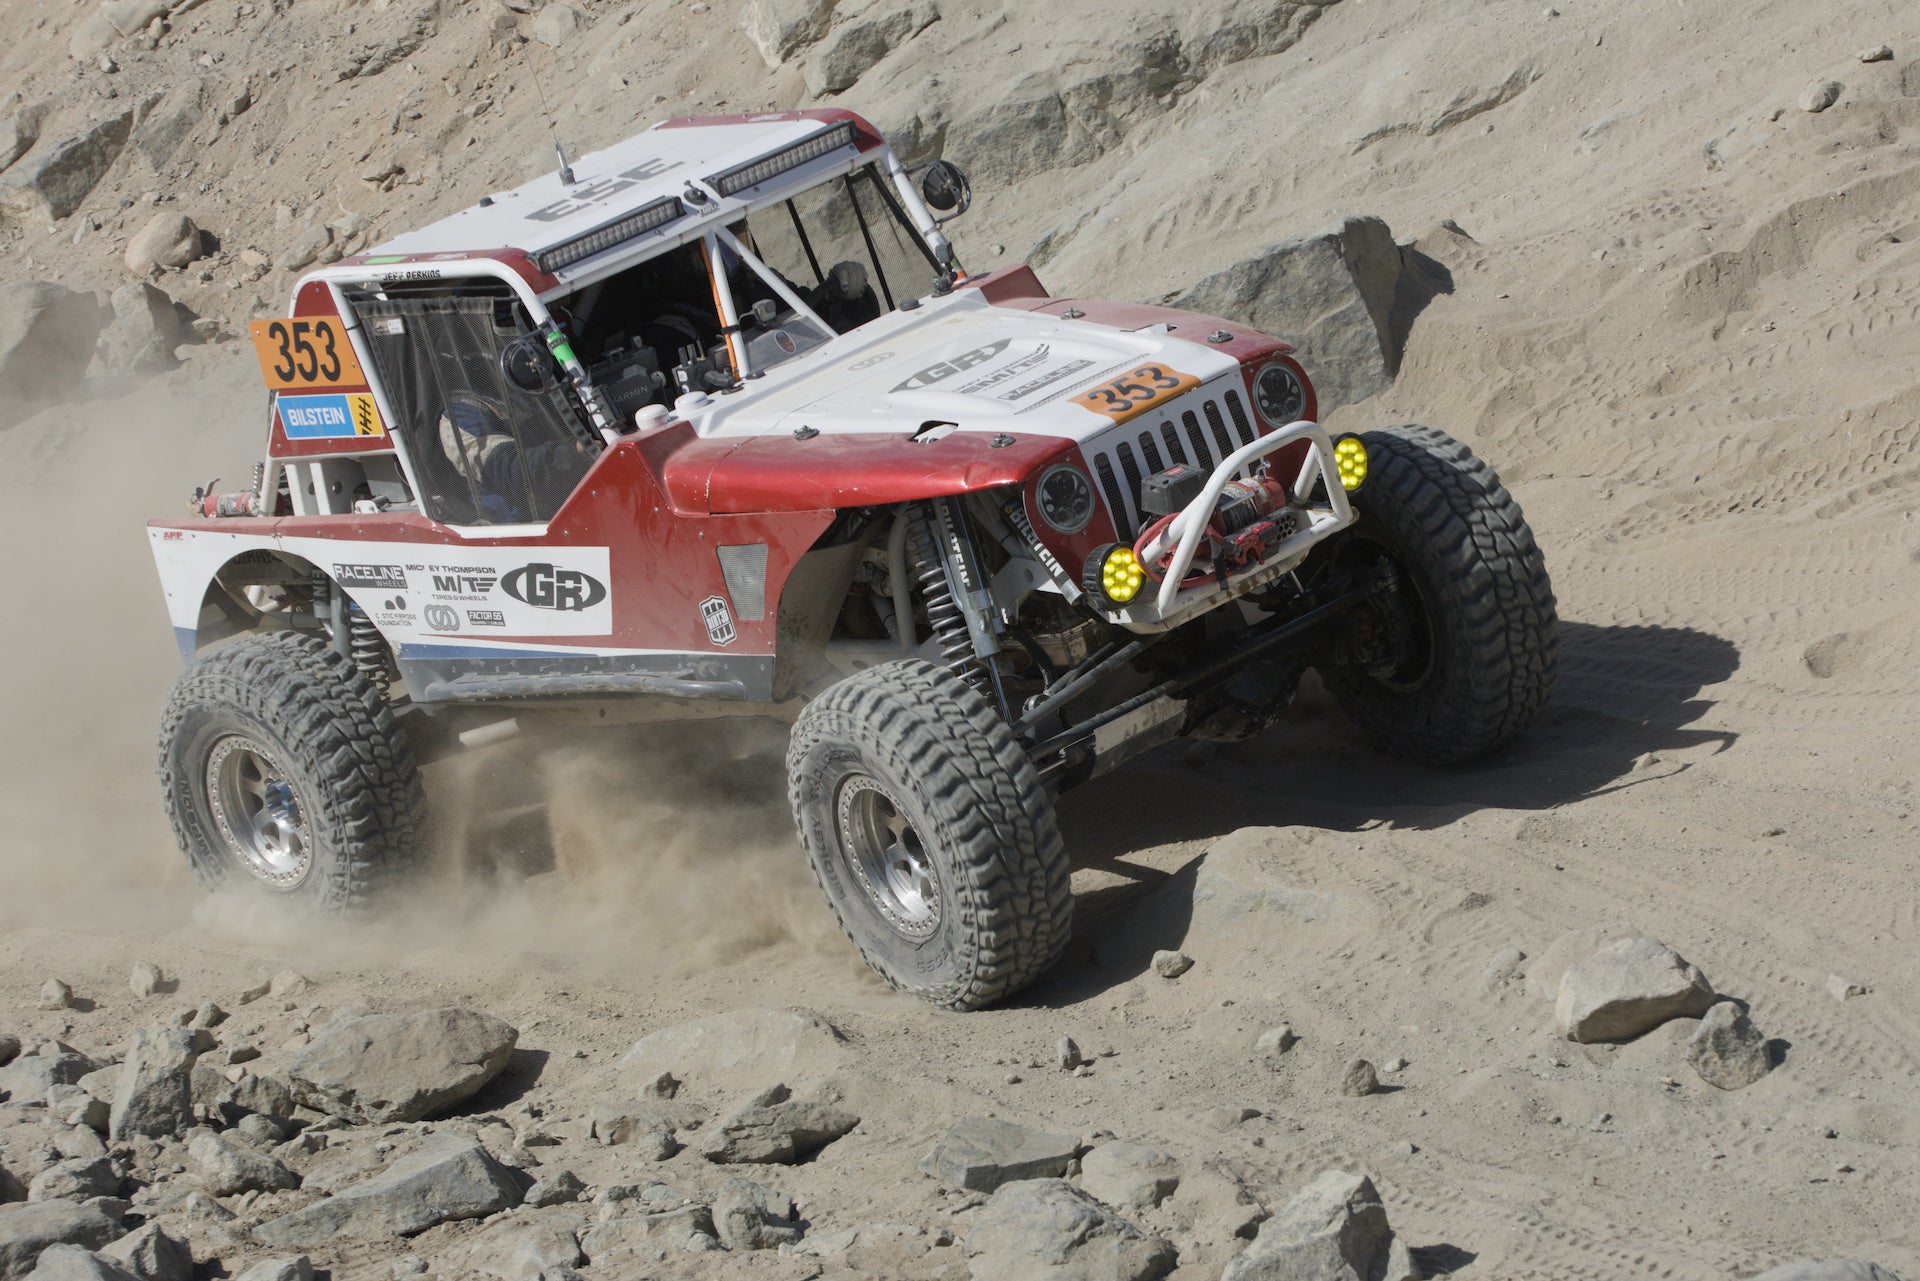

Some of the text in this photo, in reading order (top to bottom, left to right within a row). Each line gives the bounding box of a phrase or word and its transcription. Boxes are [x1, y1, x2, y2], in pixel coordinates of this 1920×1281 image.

[406, 269, 441, 280] PERKINS
[268, 320, 341, 382] 353
[1087, 366, 1180, 412] 353
[287, 406, 347, 427] BILSTEIN
[333, 564, 404, 580] RACELINE
[441, 565, 496, 574] THOMPSON
[375, 580, 407, 588] WHEELS
[432, 575, 480, 594] M/T
[525, 562, 584, 612] GR
[469, 611, 492, 620] FACTOR
